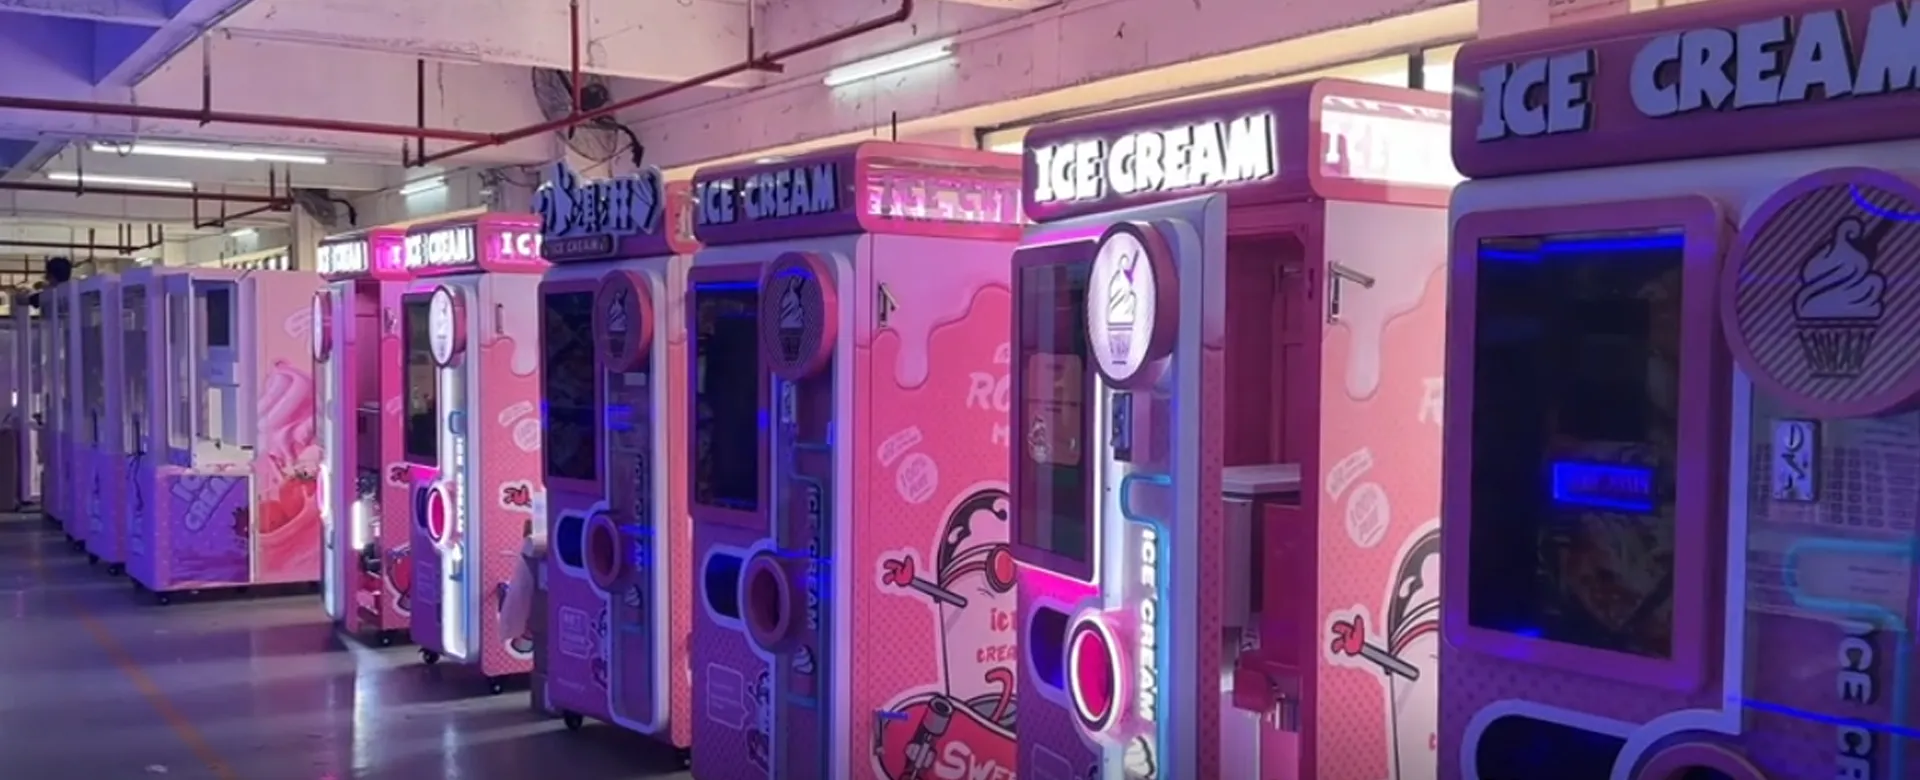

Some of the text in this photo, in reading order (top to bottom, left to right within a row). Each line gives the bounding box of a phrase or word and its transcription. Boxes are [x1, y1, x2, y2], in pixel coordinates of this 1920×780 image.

[1475, 0, 1920, 143] ICE CREAM
[697, 163, 839, 225] ICE CREAM
[1033, 112, 1277, 205] ICE CREAM
[404, 233, 429, 268] ICE
[429, 226, 476, 265] CREAM
[808, 539, 819, 631] CREAM
[1139, 529, 1158, 721] ICE CREAM
[1837, 620, 1873, 704] ICE
